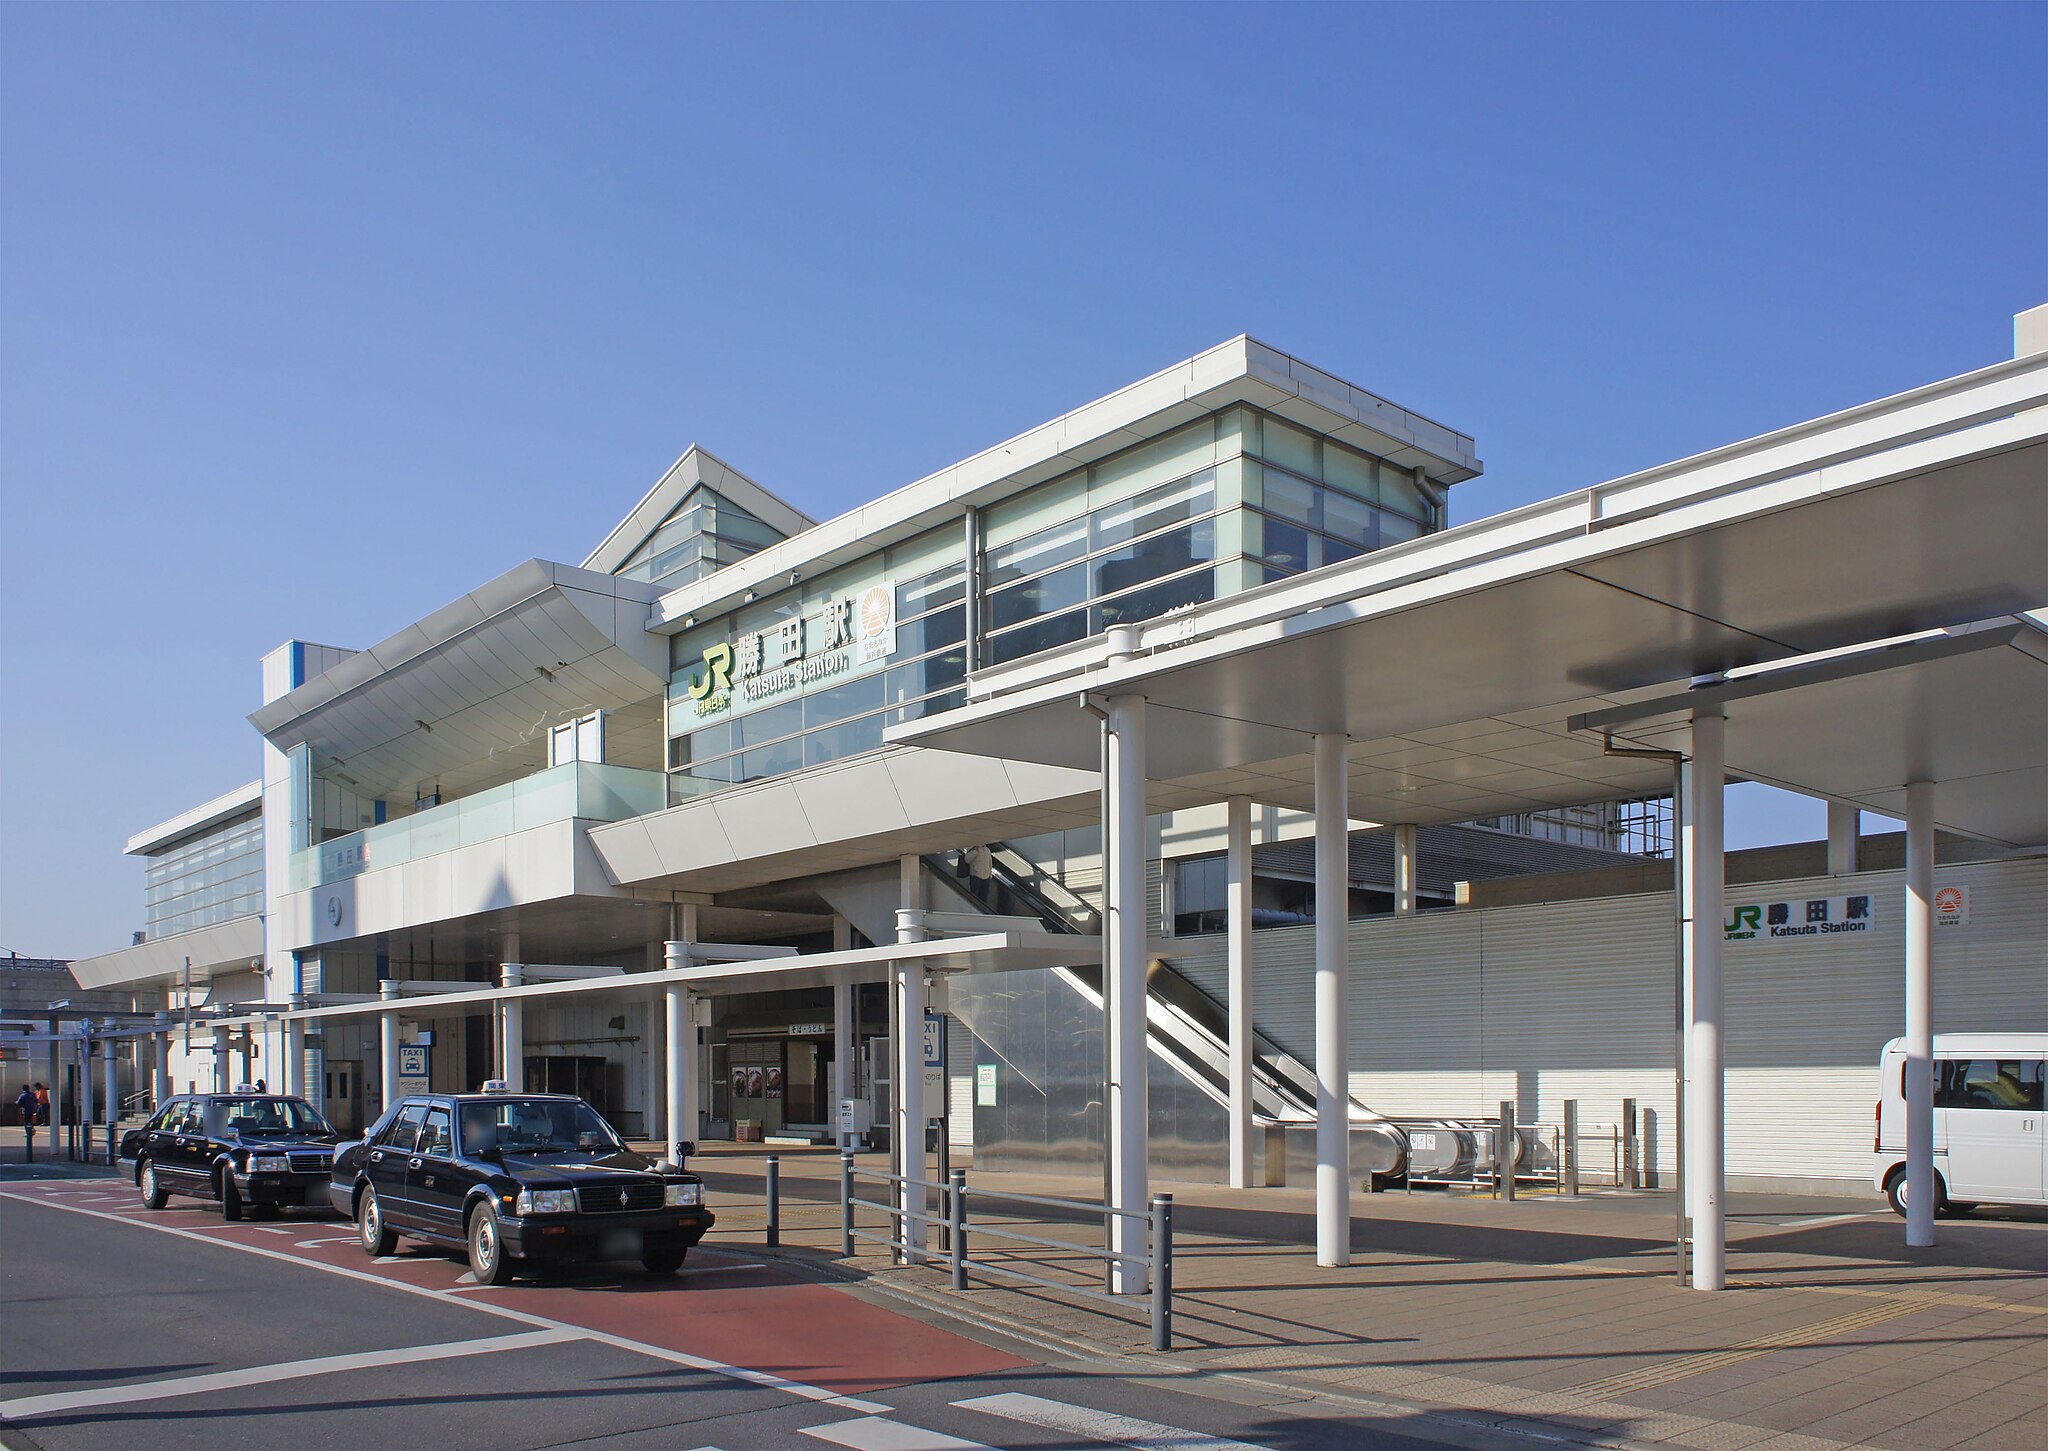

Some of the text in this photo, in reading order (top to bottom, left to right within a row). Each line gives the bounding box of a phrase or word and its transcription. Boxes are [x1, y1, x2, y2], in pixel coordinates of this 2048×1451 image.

[738, 595, 853, 678] 勝田駅
[688, 642, 732, 699] JR
[742, 652, 845, 700] Katsuta Station
[694, 693, 727, 715] JR東日本
[1724, 906, 1761, 931] JR
[1767, 896, 1869, 925] 勝田駅
[1770, 920, 1866, 937] Katsuta Station
[924, 1023, 936, 1034] XI
